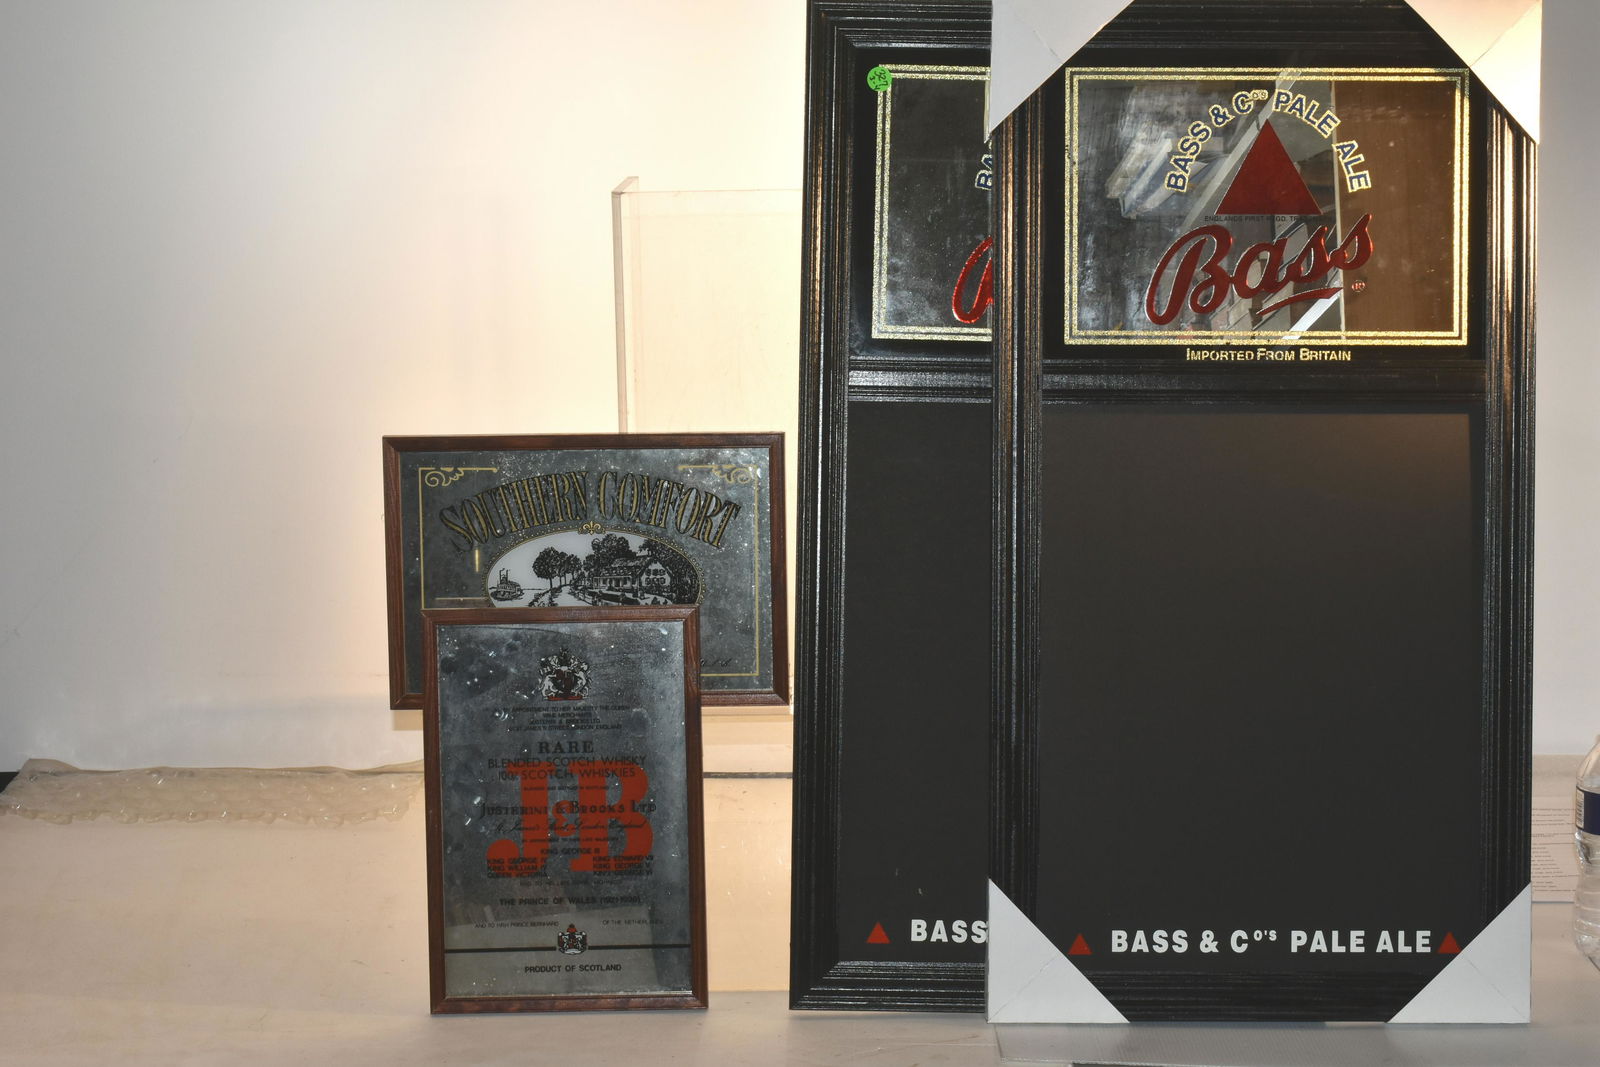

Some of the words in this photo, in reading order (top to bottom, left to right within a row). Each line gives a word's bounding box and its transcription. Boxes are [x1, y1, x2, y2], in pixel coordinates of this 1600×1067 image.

[1165, 121, 1212, 192] BASS
[1209, 104, 1235, 128] &
[1272, 89, 1341, 138] PALE
[1332, 140, 1372, 193] ALE
[1146, 213, 1374, 326] Bass
[439, 470, 589, 553] SOUTHERN
[597, 470, 742, 548] COMFORT
[538, 740, 594, 754] RARE
[488, 758, 541, 769] BLENDED
[546, 756, 596, 768] SCOTCH
[600, 754, 648, 766] WHISKY
[522, 768, 574, 780] SCOTCH
[580, 768, 636, 778] WHISKIES
[632, 800, 656, 813] LTD
[499, 898, 516, 906] THE
[910, 919, 988, 944] BASS
[1111, 930, 1188, 954] BASS
[1199, 930, 1220, 953] &
[1290, 930, 1366, 953] PALE
[1376, 930, 1431, 953] ALE
[524, 965, 562, 973] PRODUCT
[579, 964, 622, 972] SCOTLAND
